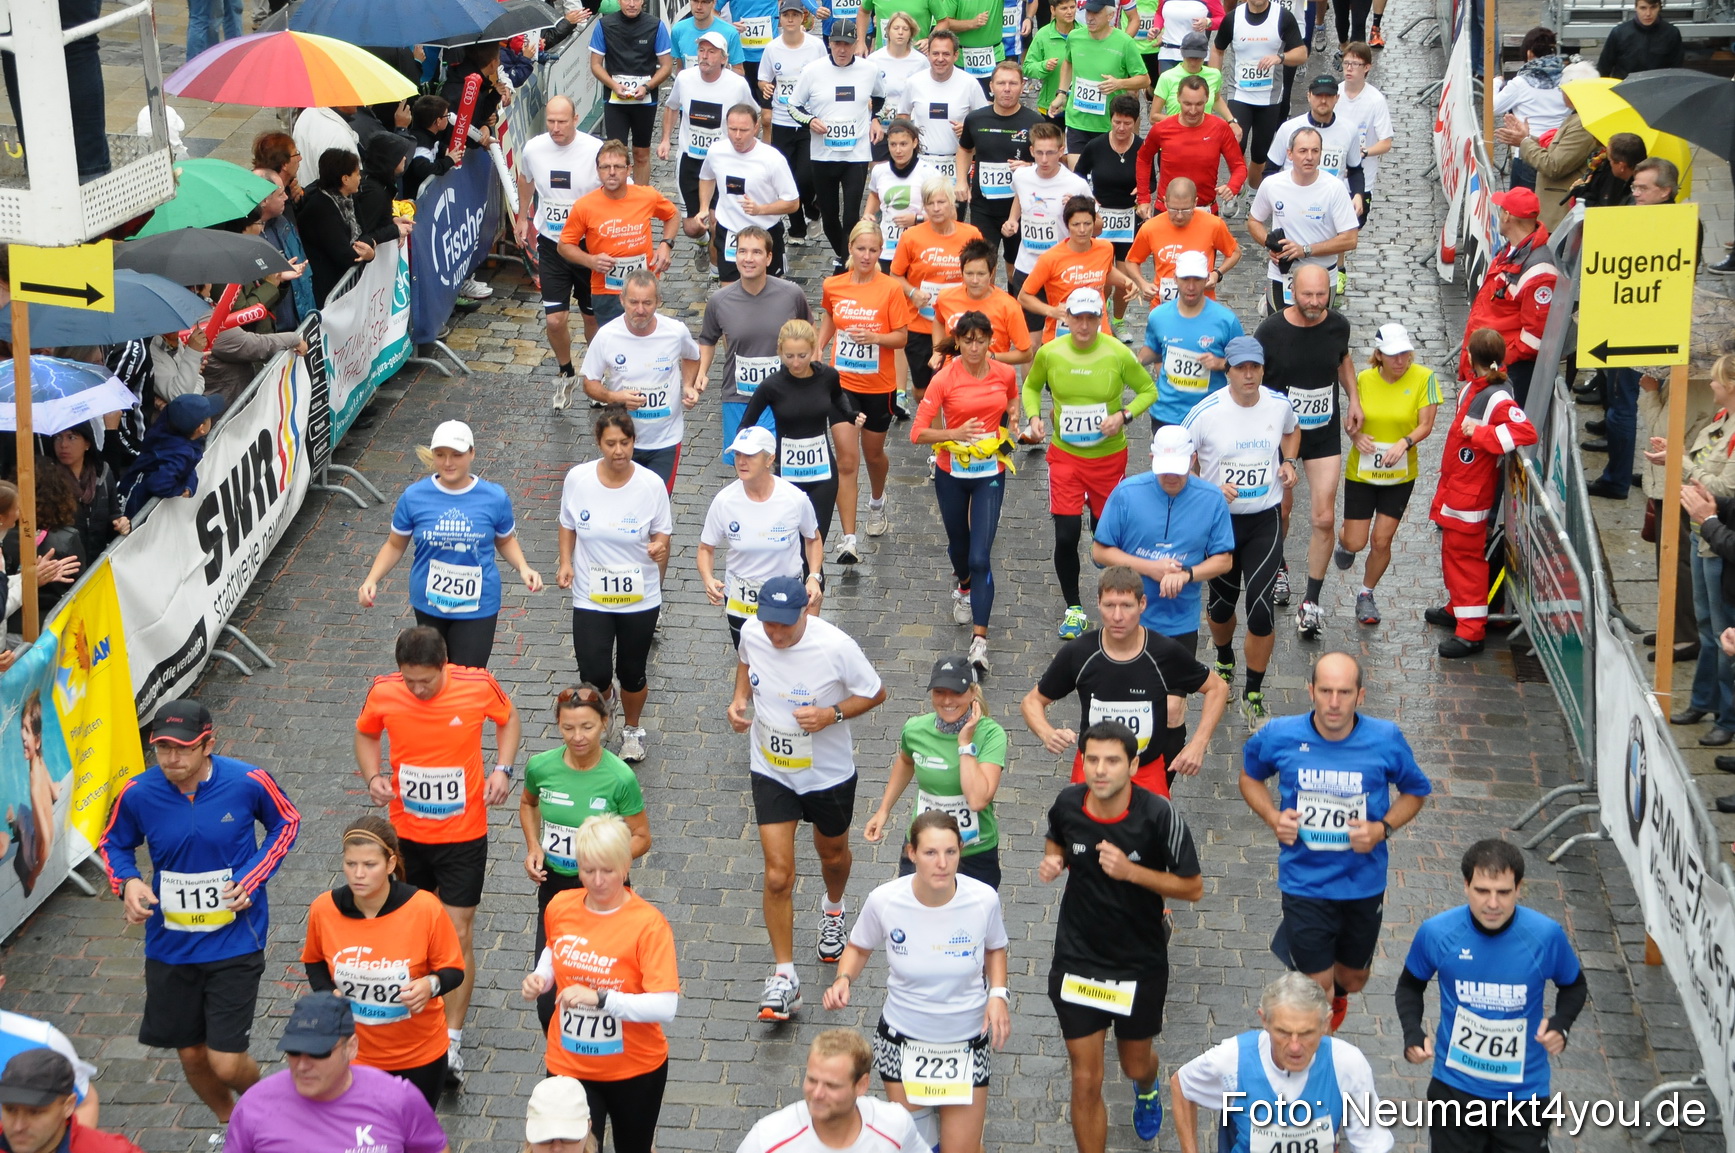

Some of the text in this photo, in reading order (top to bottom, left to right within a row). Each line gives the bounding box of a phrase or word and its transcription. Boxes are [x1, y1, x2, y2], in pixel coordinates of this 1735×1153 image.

[744, 25, 765, 38] 347
[966, 54, 992, 67] 3020
[1242, 68, 1270, 80] 2692
[1076, 86, 1102, 102] 2821
[455, 113, 467, 135] BKK
[826, 125, 856, 139] 2994
[981, 171, 1013, 185] 3129
[606, 222, 643, 236] Fischer
[1101, 216, 1131, 230] 3053
[1024, 224, 1054, 240] 2016
[1586, 248, 1691, 280] Jugend-
[1068, 268, 1103, 282] Fischer
[1613, 280, 1662, 305] lauf
[839, 303, 878, 318] Fischer
[839, 340, 874, 359] 2781
[1173, 359, 1203, 378] 382
[1173, 377, 1198, 387] Gerhard
[635, 410, 661, 418] Thomas
[1291, 398, 1330, 415] 2788
[1064, 417, 1103, 434] 2719
[1235, 440, 1271, 450] heinloth
[787, 449, 824, 466] 2901
[1373, 453, 1393, 469] 8
[793, 467, 818, 476] Natalie
[1225, 468, 1267, 487] 2267
[432, 573, 477, 598] 2250
[600, 576, 632, 593] 118
[602, 595, 631, 605] maryam
[162, 661, 177, 683] die
[769, 735, 794, 756] 85
[773, 757, 790, 767] Toni
[1298, 768, 1363, 786] HUBER
[405, 780, 460, 801] 2019
[417, 804, 446, 814] Holger
[162, 876, 220, 886] PARTL Neumarkt
[175, 886, 220, 909] 113
[190, 914, 206, 924] HG
[345, 956, 411, 971] Fischer
[559, 943, 619, 968] Fischer
[562, 958, 611, 976] AUTOMOBILE
[341, 980, 401, 1004] 2782
[1077, 984, 1117, 1002] Matthias
[1455, 980, 1527, 999] HUBER
[563, 1010, 617, 1039] 2779
[1457, 1012, 1514, 1034] PARTL Neumarkt
[575, 1042, 600, 1054] Petra
[1458, 1027, 1518, 1058] 2764
[928, 1046, 961, 1056] Neumarkt
[915, 1055, 959, 1079] 223
[1461, 1054, 1508, 1073] Christoph
[924, 1085, 947, 1096] Nora
[1252, 1126, 1320, 1139] PARTL Neumarkt
